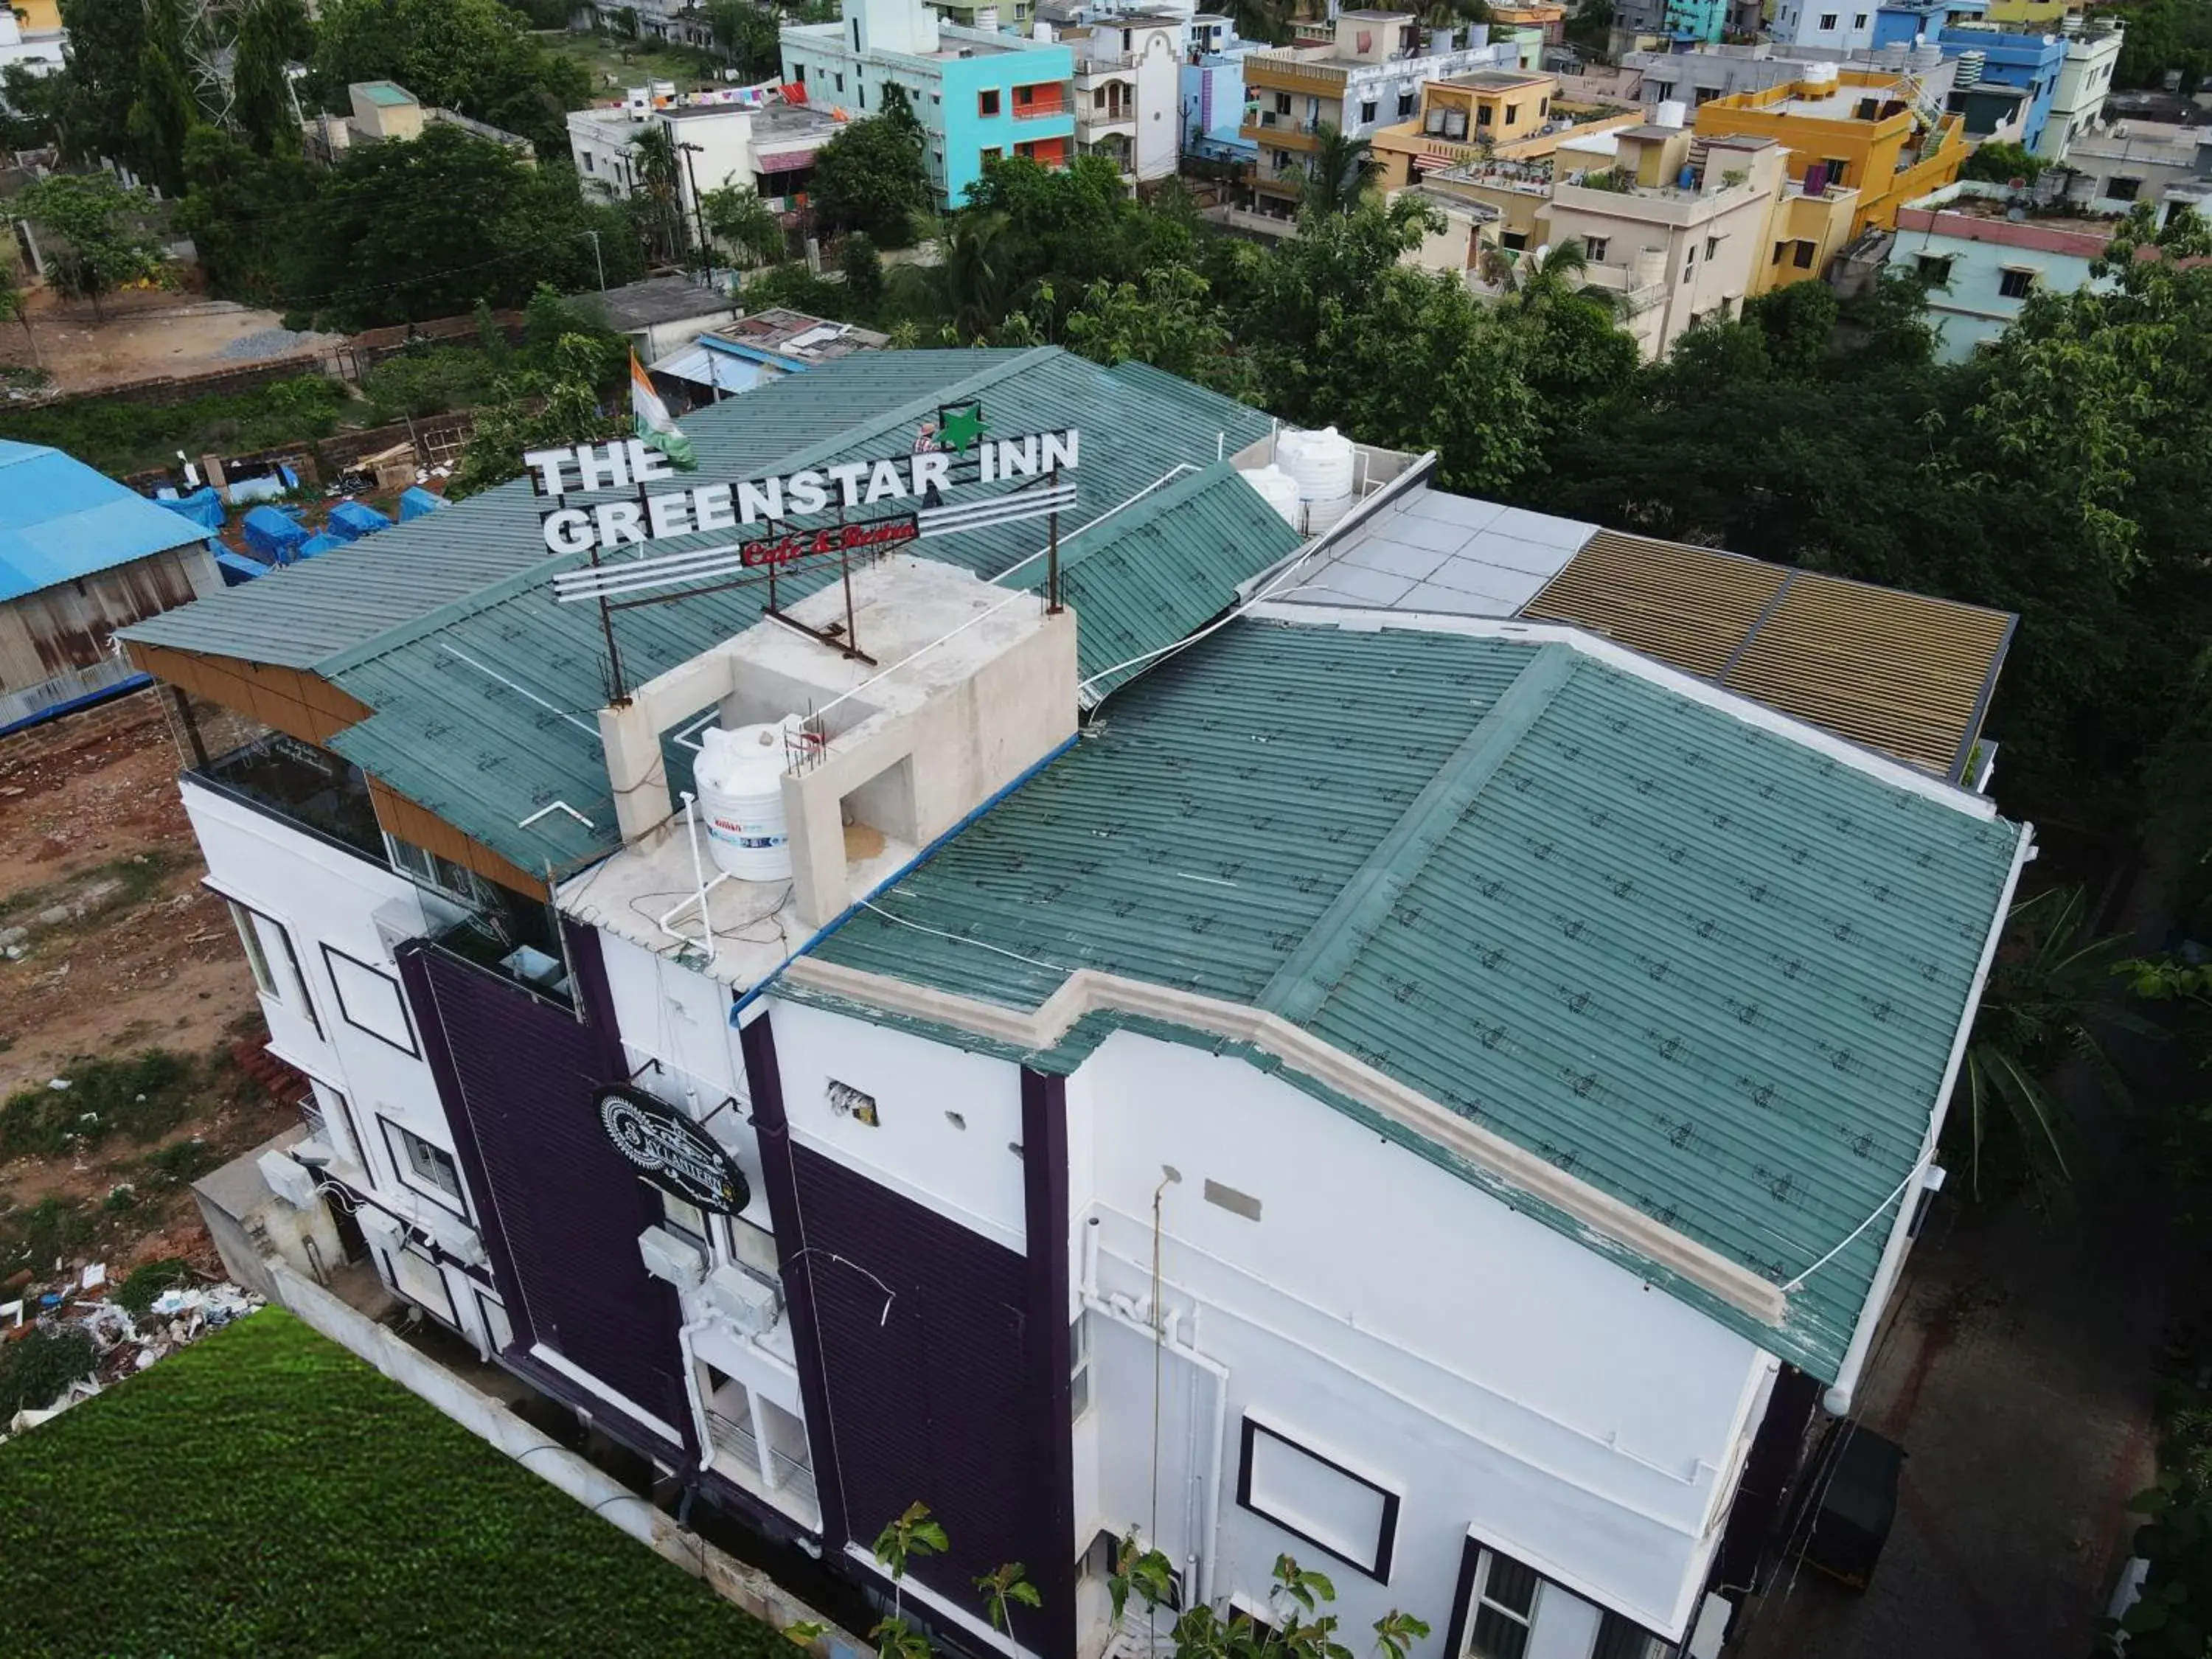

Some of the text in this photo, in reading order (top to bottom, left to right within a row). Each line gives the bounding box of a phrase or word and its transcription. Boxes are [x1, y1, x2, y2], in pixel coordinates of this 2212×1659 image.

[524, 439, 673, 497] THE
[543, 429, 1078, 554] GREENSTAR INN
[743, 531, 804, 567] Café
[811, 529, 831, 554] &
